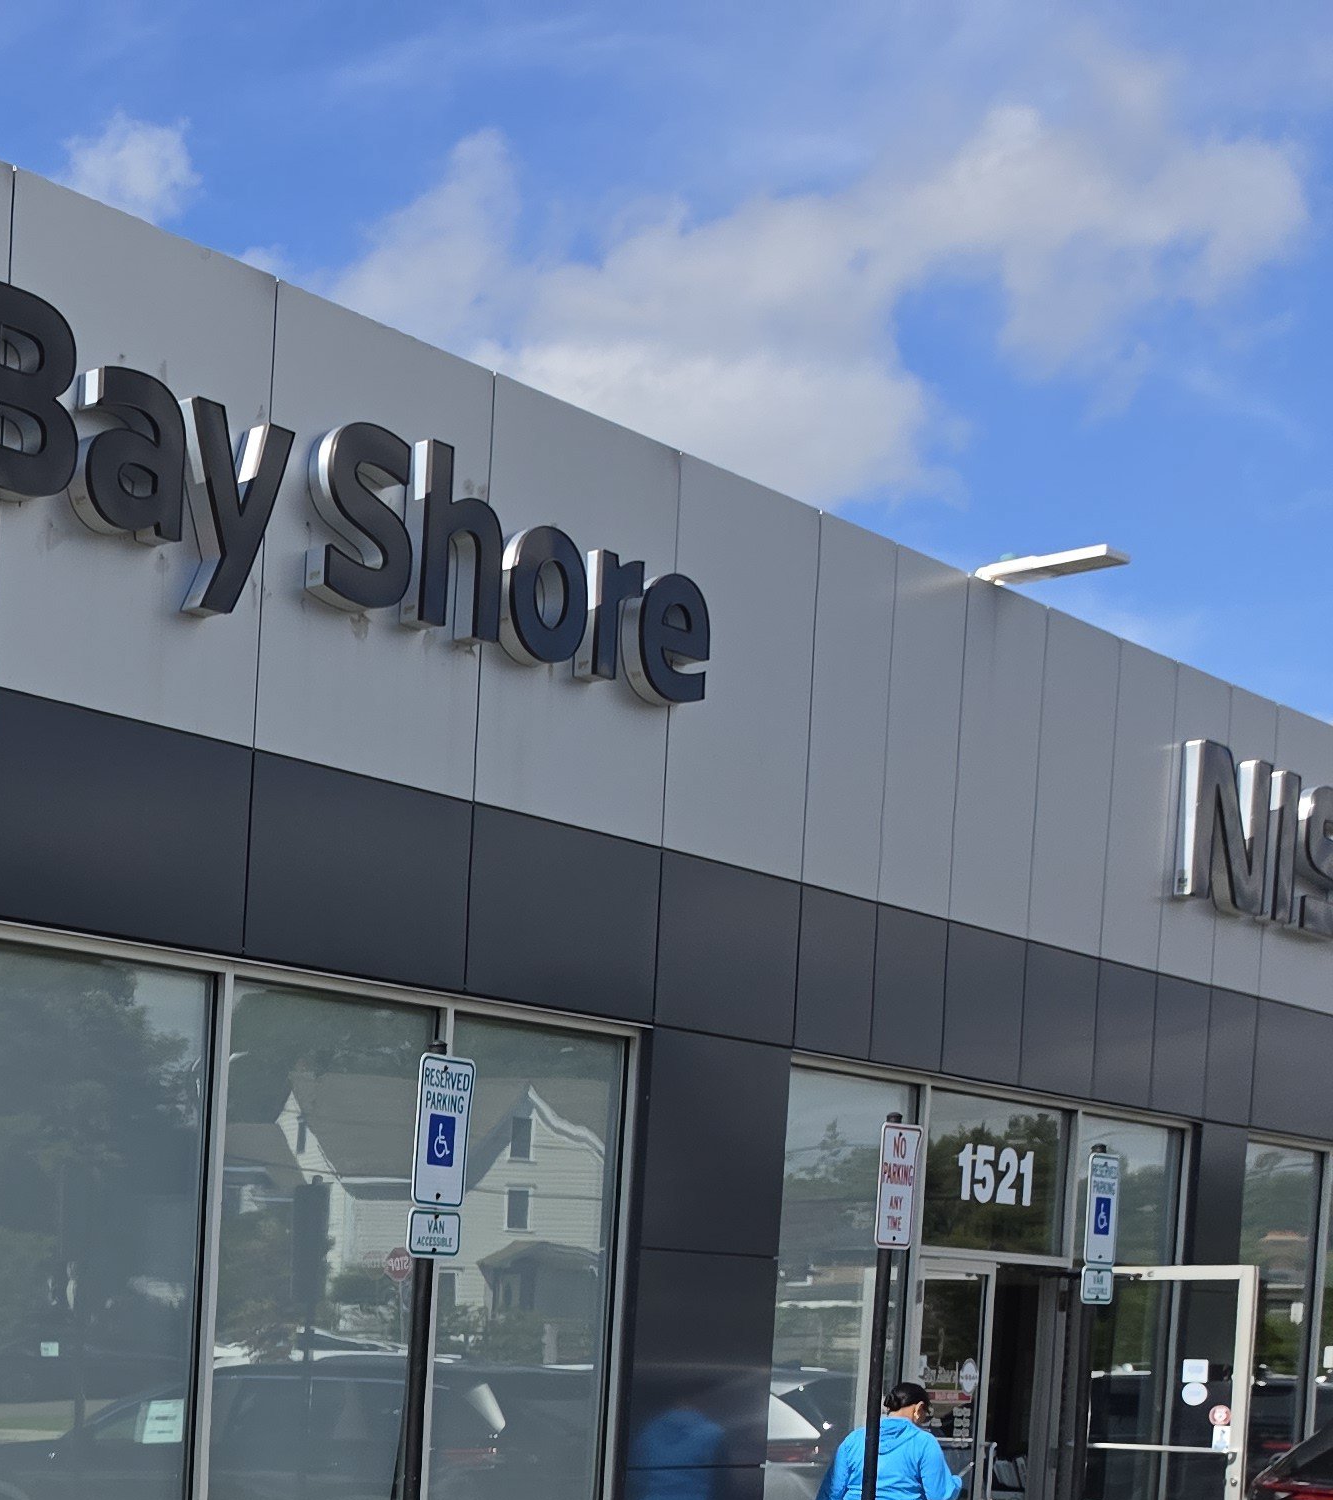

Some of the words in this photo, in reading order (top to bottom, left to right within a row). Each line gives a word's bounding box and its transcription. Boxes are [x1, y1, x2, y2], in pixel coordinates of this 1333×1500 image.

[305, 422, 710, 706] Shore
[424, 1067, 470, 1092] RESERVED
[425, 1090, 464, 1114] PARKING
[893, 1136, 907, 1159] NO
[882, 1161, 914, 1187] PARKING
[958, 1143, 1035, 1207] 1521
[889, 1196, 903, 1211] ANY
[427, 1219, 445, 1234] VAN
[886, 1216, 902, 1232] TIME
[416, 1236, 453, 1247] ACCESSIBLE
